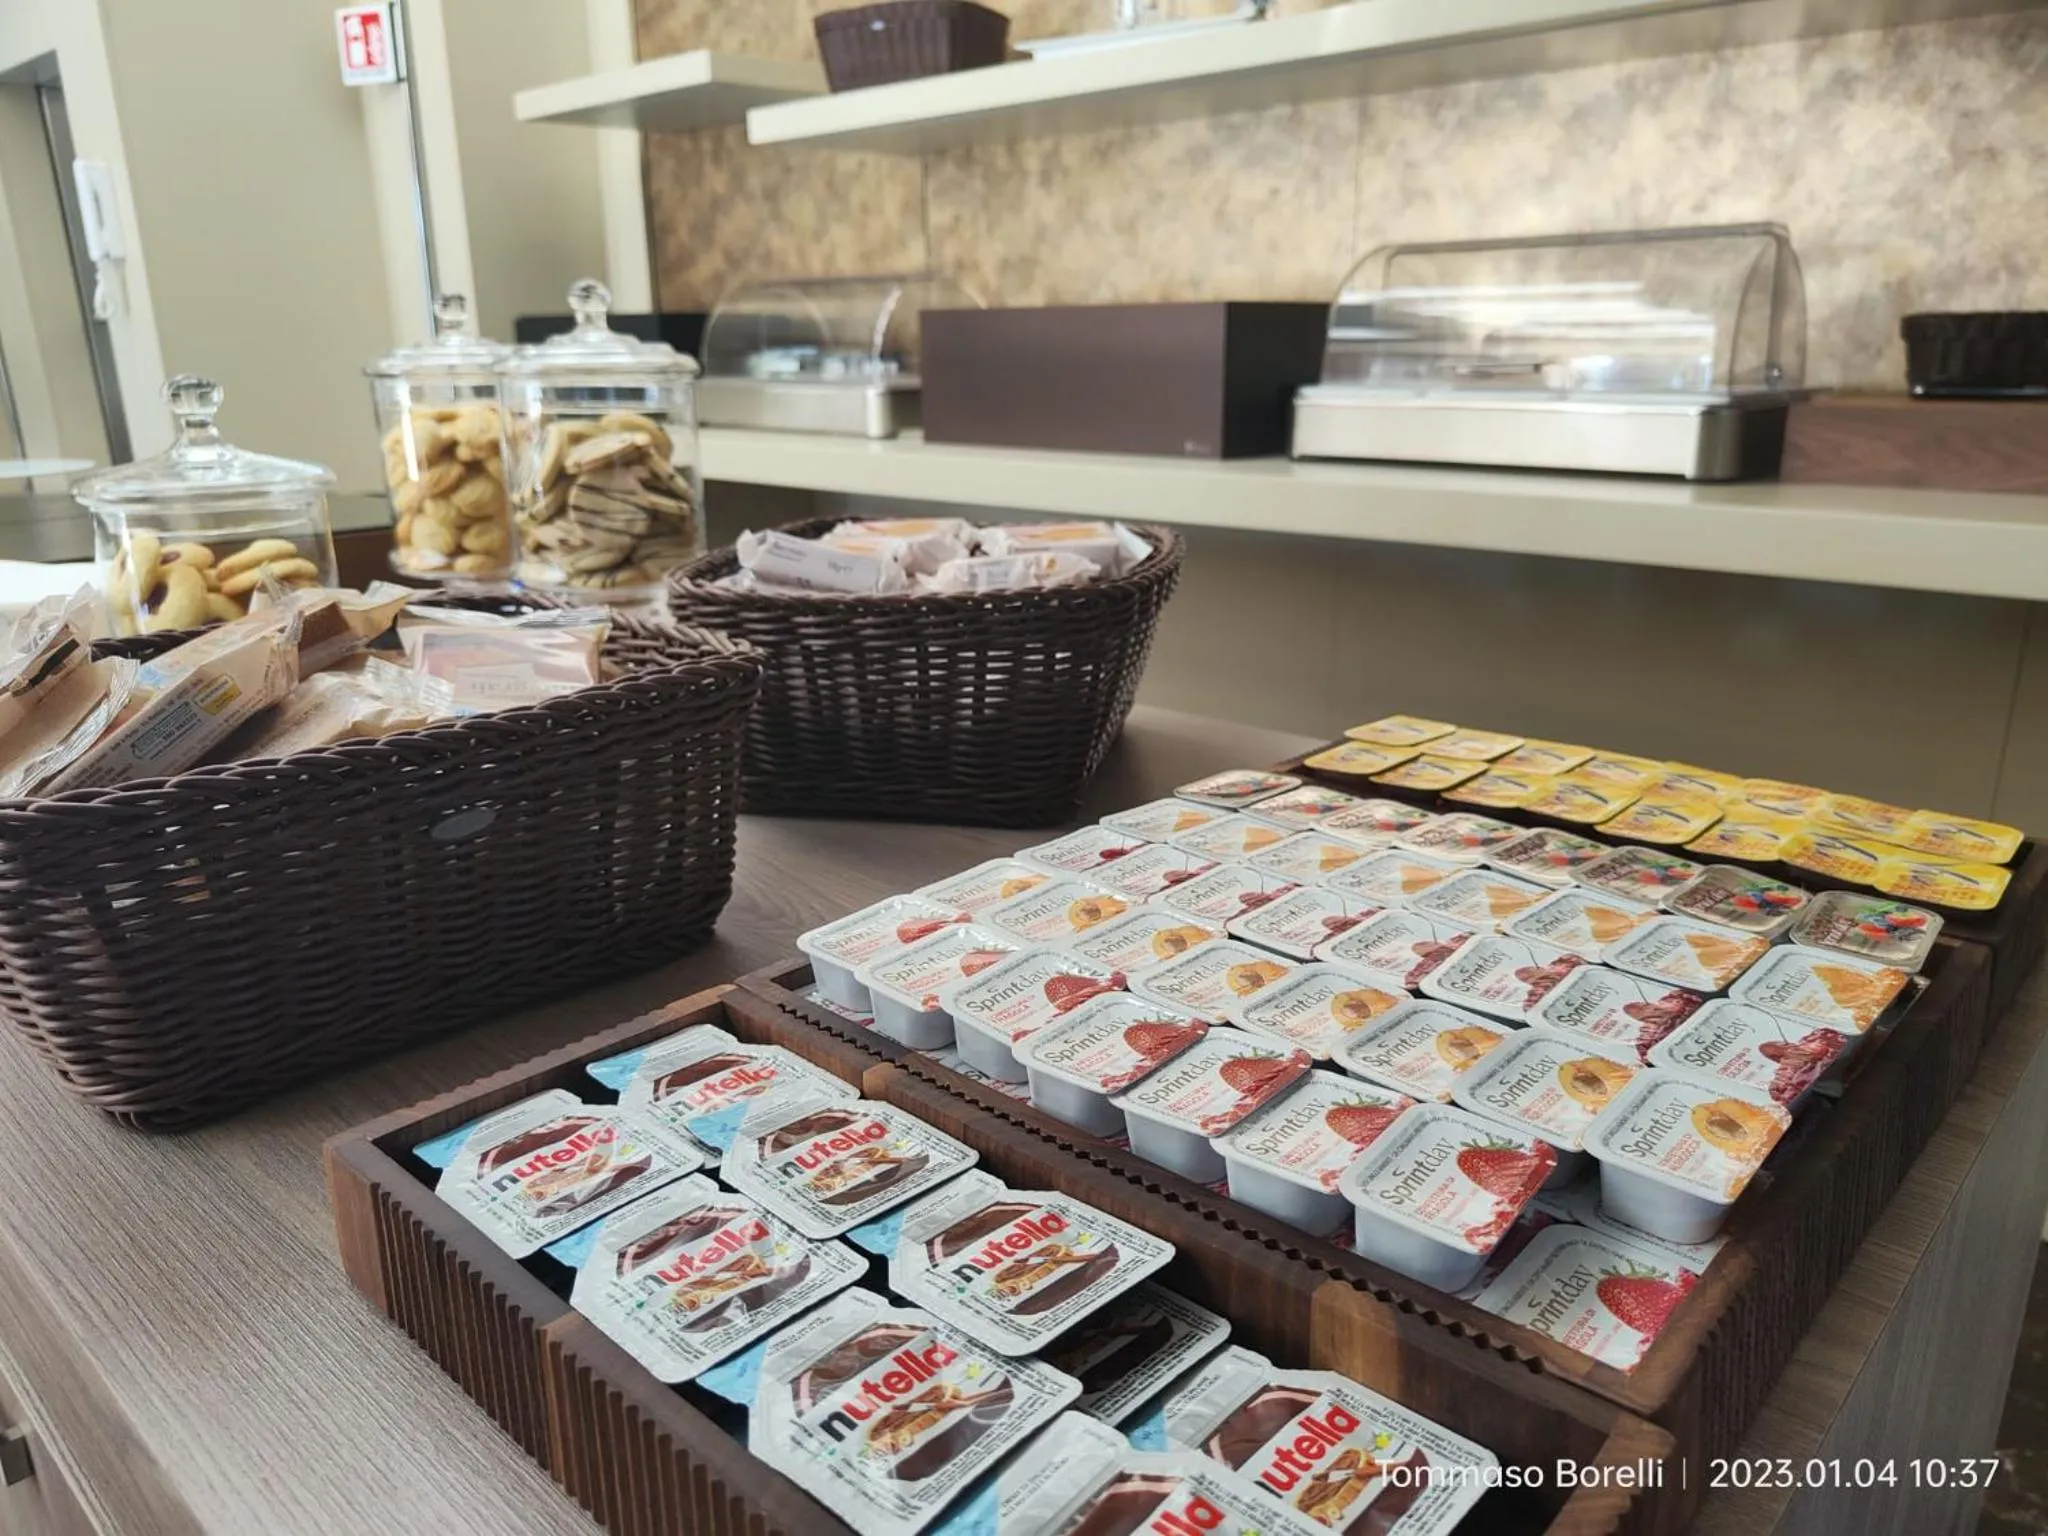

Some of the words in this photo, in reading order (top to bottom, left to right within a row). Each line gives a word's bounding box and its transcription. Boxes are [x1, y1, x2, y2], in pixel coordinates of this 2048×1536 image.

[965, 966, 1052, 1014] Sprintday
[1450, 947, 1513, 993] Sprintday
[1257, 984, 1336, 1029] Sprintday
[1556, 981, 1620, 1028] Sprintday
[1044, 1017, 1128, 1064] Sprintday
[1361, 1023, 1438, 1069] Sprintday
[1683, 1017, 1756, 1069] Sprintday
[1138, 1052, 1222, 1105] Sprintday
[1487, 1054, 1558, 1109] Sprintday
[776, 1120, 889, 1180] nutella
[1245, 1098, 1326, 1156] Sprintday
[1620, 1097, 1691, 1158] Sprintday
[492, 1125, 618, 1193] nutella
[1379, 1137, 1456, 1206] Sprintday
[632, 1217, 771, 1297] nutella
[951, 1212, 1071, 1285] nutella
[1529, 1263, 1600, 1342] printday
[819, 1343, 960, 1443] nutella
